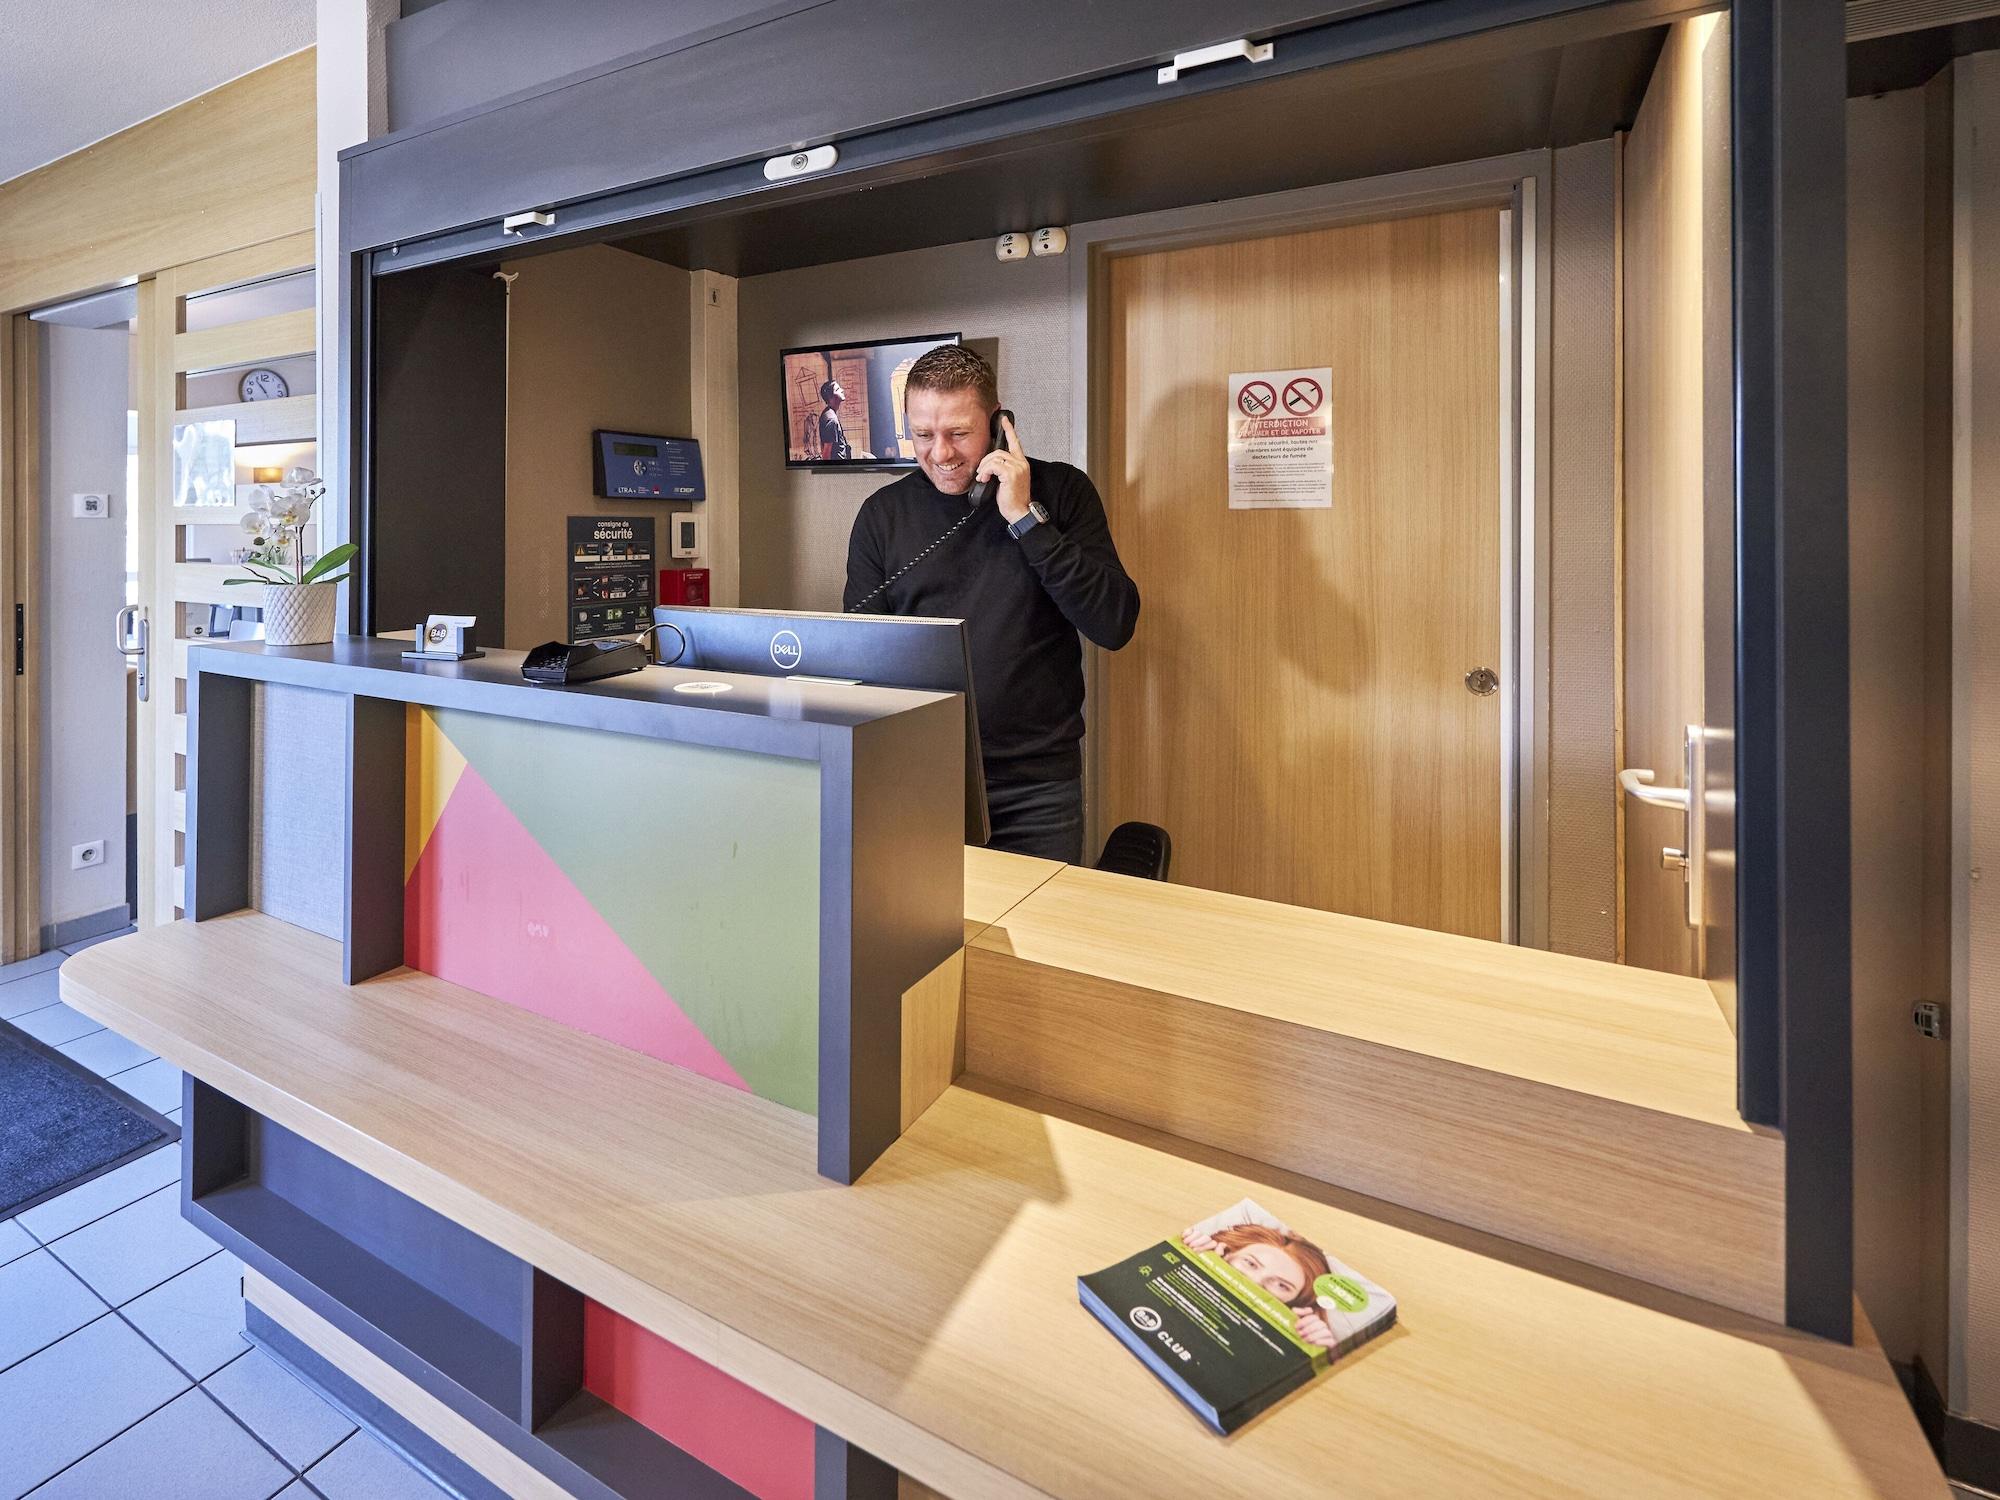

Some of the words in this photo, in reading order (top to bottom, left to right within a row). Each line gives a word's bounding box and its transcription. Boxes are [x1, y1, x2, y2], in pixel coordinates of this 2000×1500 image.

[261, 374, 270, 382] 12
[593, 528, 633, 540] sécurité
[430, 628, 446, 637] B&B
[774, 644, 798, 655] DELL
[1157, 1331, 1192, 1362] CLUB
